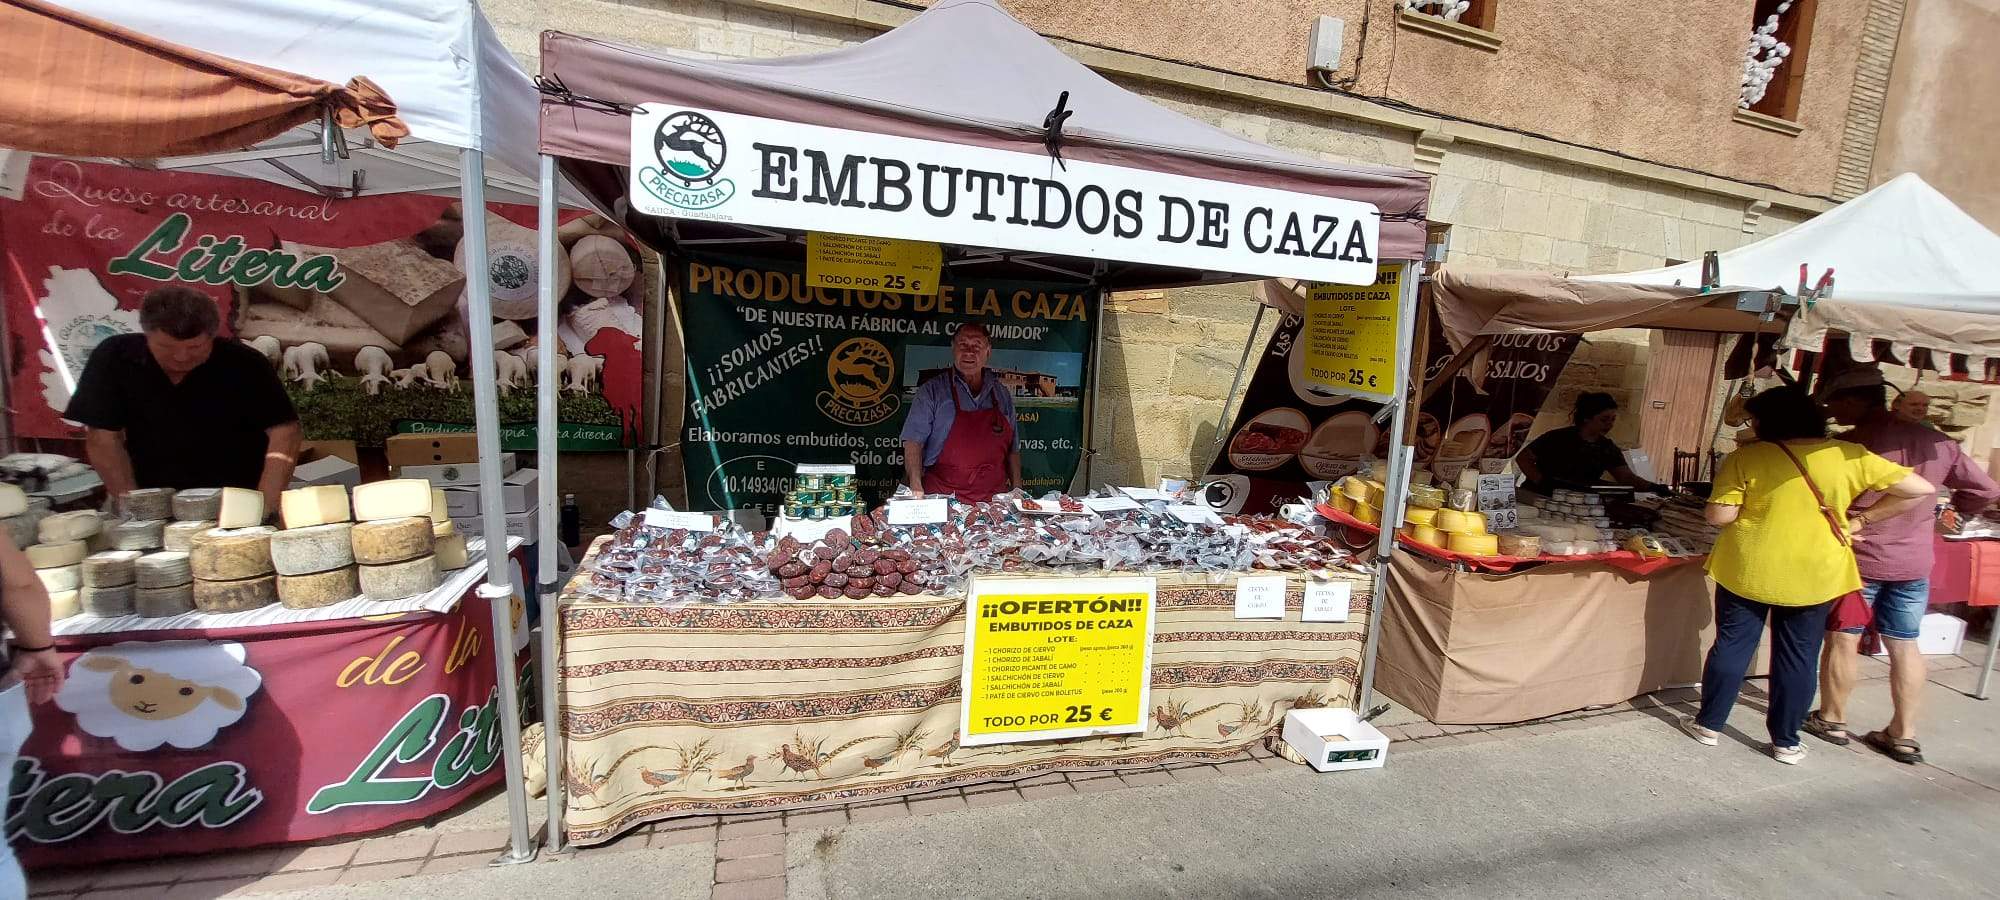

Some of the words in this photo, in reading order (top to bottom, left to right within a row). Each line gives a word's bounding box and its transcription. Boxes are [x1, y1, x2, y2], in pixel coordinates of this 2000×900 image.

[34, 161, 154, 208] Queso
[166, 191, 339, 222] artesanal
[648, 176, 726, 206] PRECAZASA
[751, 142, 1143, 239] EMBUTIDOS
[1156, 194, 1230, 249] DE
[1243, 206, 1374, 264] CAZA
[41, 212, 73, 238] de
[85, 213, 123, 241] la
[108, 212, 346, 293] Litera
[818, 274, 852, 285] TODO
[855, 277, 879, 287] POR
[883, 275, 905, 290] 25
[911, 280, 921, 291] €
[913, 284, 956, 314] DE
[965, 287, 1002, 317] LA
[1011, 290, 1088, 321] CAZA
[1313, 292, 1353, 301] EMBUTIDOS
[1354, 292, 1365, 301] DE
[1367, 291, 1391, 301] CAZA
[772, 310, 847, 329] NUESTRA
[851, 313, 918, 334] FÁBRICA
[921, 320, 941, 336] AL
[707, 327, 783, 386] ¡¡SOMOS
[690, 333, 824, 420] FABRICANTES!!
[1310, 367, 1329, 380] TODO
[1330, 370, 1346, 382] POR
[1348, 368, 1364, 386] 25
[1368, 375, 1377, 388] €
[824, 400, 894, 423] PRECAZASA
[573, 427, 617, 441] directa.
[688, 426, 781, 444] Elaboramos
[786, 431, 869, 449] embutidos,
[1051, 437, 1074, 450] etc.
[756, 460, 766, 471] E
[849, 450, 882, 466] Sólo
[722, 475, 793, 495] 10.14934/G
[982, 596, 1142, 618] ¡¡OFERTÓN!!
[989, 620, 1072, 632] EMBUTIDOS
[1075, 620, 1094, 630] DE
[1097, 618, 1134, 630] CAZA
[1033, 645, 1056, 653] CIERVO
[1047, 635, 1078, 643] LOTE:
[336, 635, 427, 689] de
[444, 618, 482, 675] la
[1055, 688, 1082, 696] BOLETUS
[984, 715, 1026, 728] TODO
[1029, 713, 1059, 724] POR
[1065, 704, 1093, 723] 25
[1099, 708, 1113, 721] €
[305, 693, 504, 816] Lit
